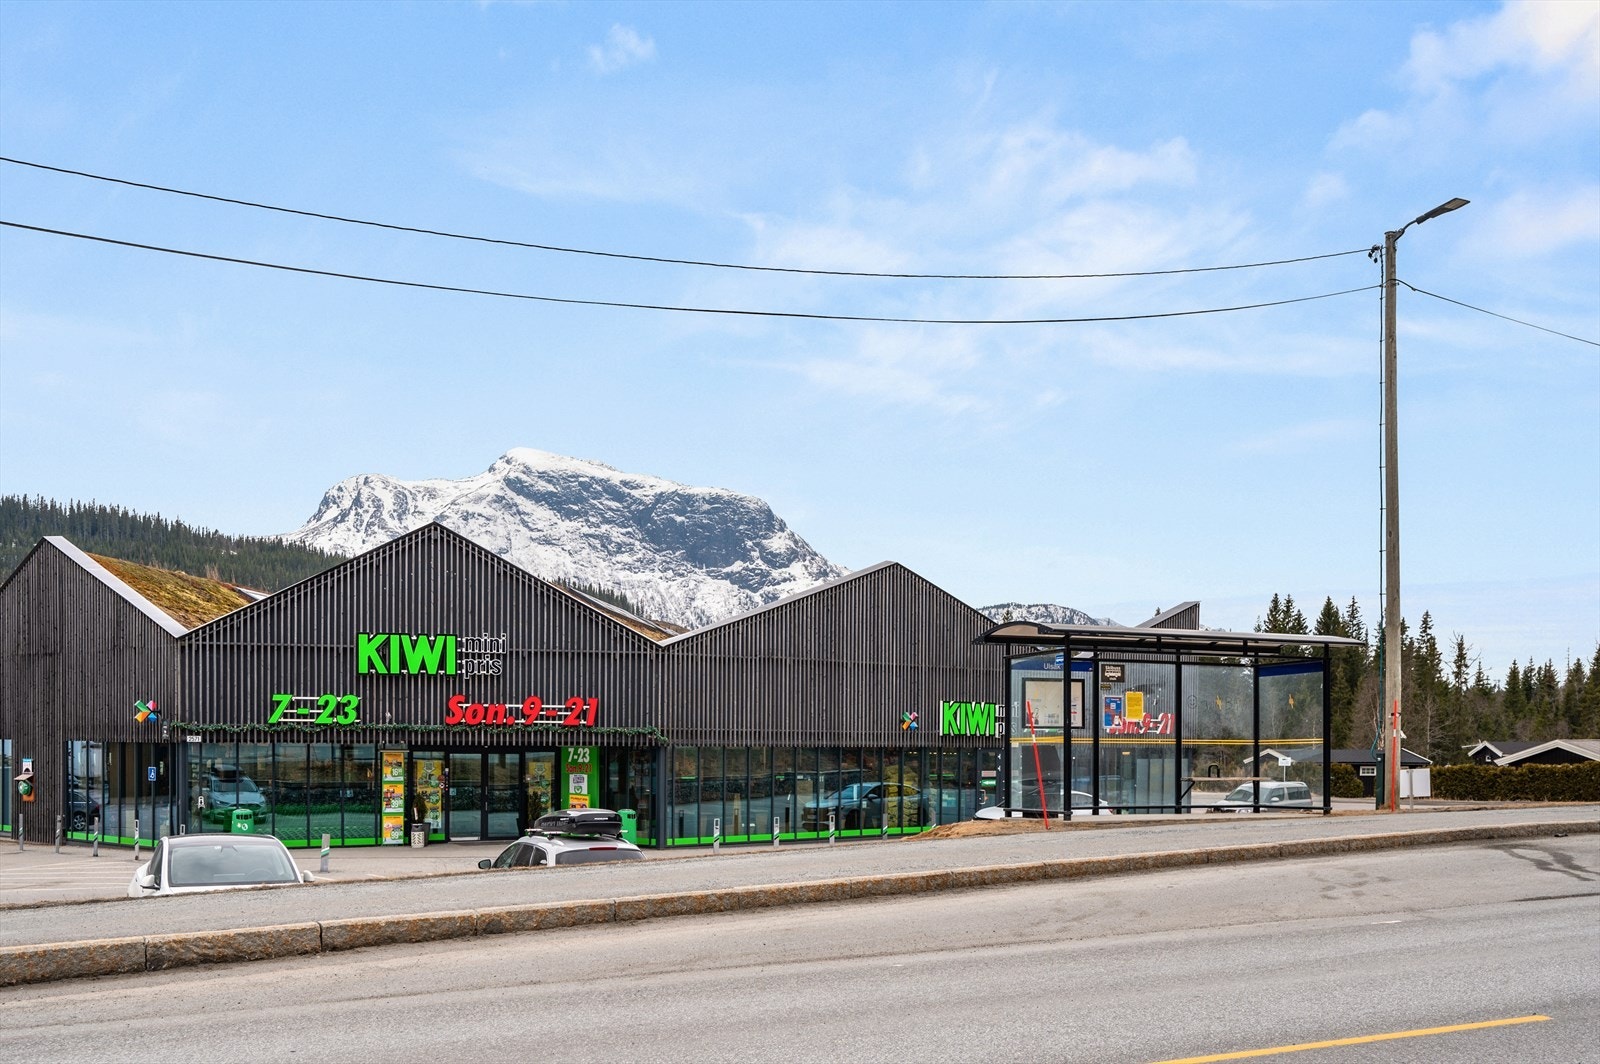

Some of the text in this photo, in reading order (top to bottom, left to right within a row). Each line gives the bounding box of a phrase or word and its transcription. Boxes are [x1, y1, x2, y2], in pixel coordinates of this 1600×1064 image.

[357, 633, 457, 676] KIWI
[464, 632, 507, 654] mini
[463, 654, 503, 679] pris
[267, 694, 359, 725] 7-23
[445, 694, 515, 726] Søn.
[941, 701, 996, 736] KIWI
[568, 748, 590, 763] 7-23
